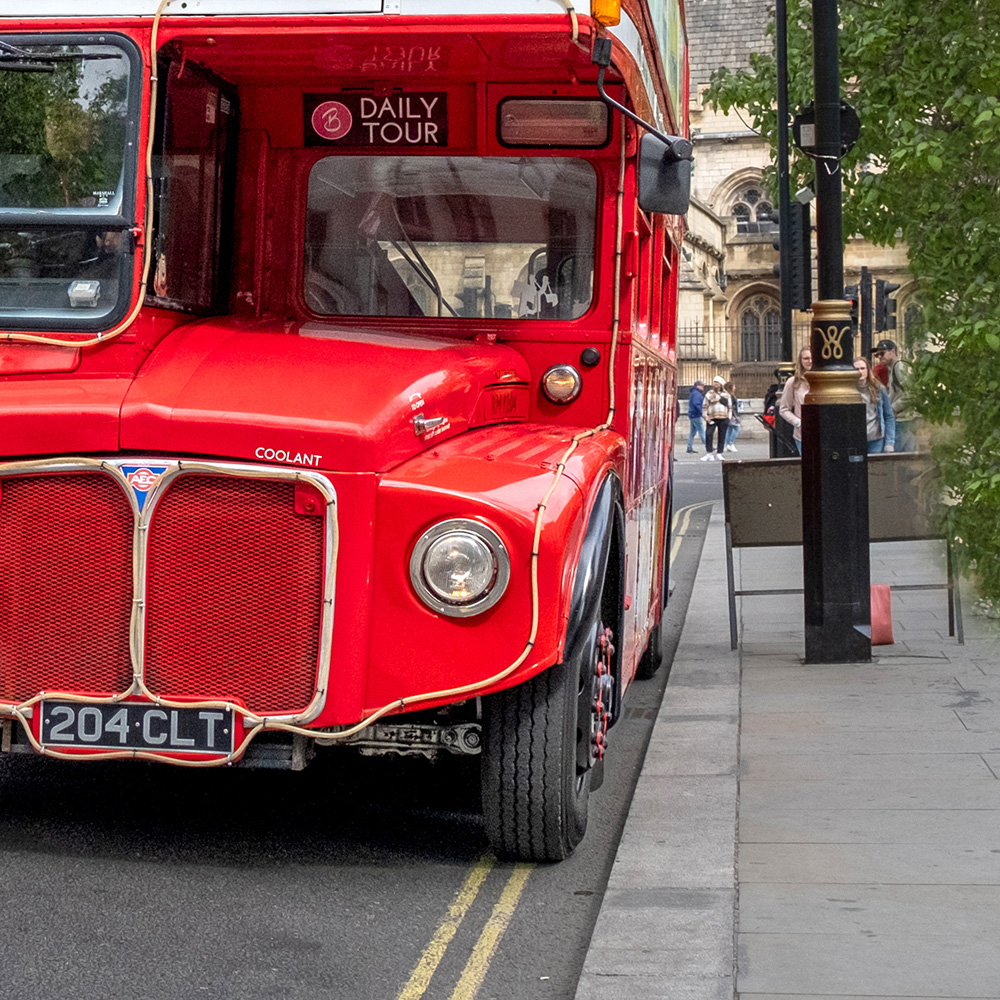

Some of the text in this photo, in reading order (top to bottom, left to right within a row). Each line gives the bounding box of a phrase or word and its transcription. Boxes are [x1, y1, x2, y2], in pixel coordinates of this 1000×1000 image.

[360, 97, 439, 119] DAILY
[362, 122, 439, 143] TOUR
[255, 446, 323, 467] COOLANT
[130, 474, 158, 485] AEC
[49, 705, 224, 748] 204 CLT
